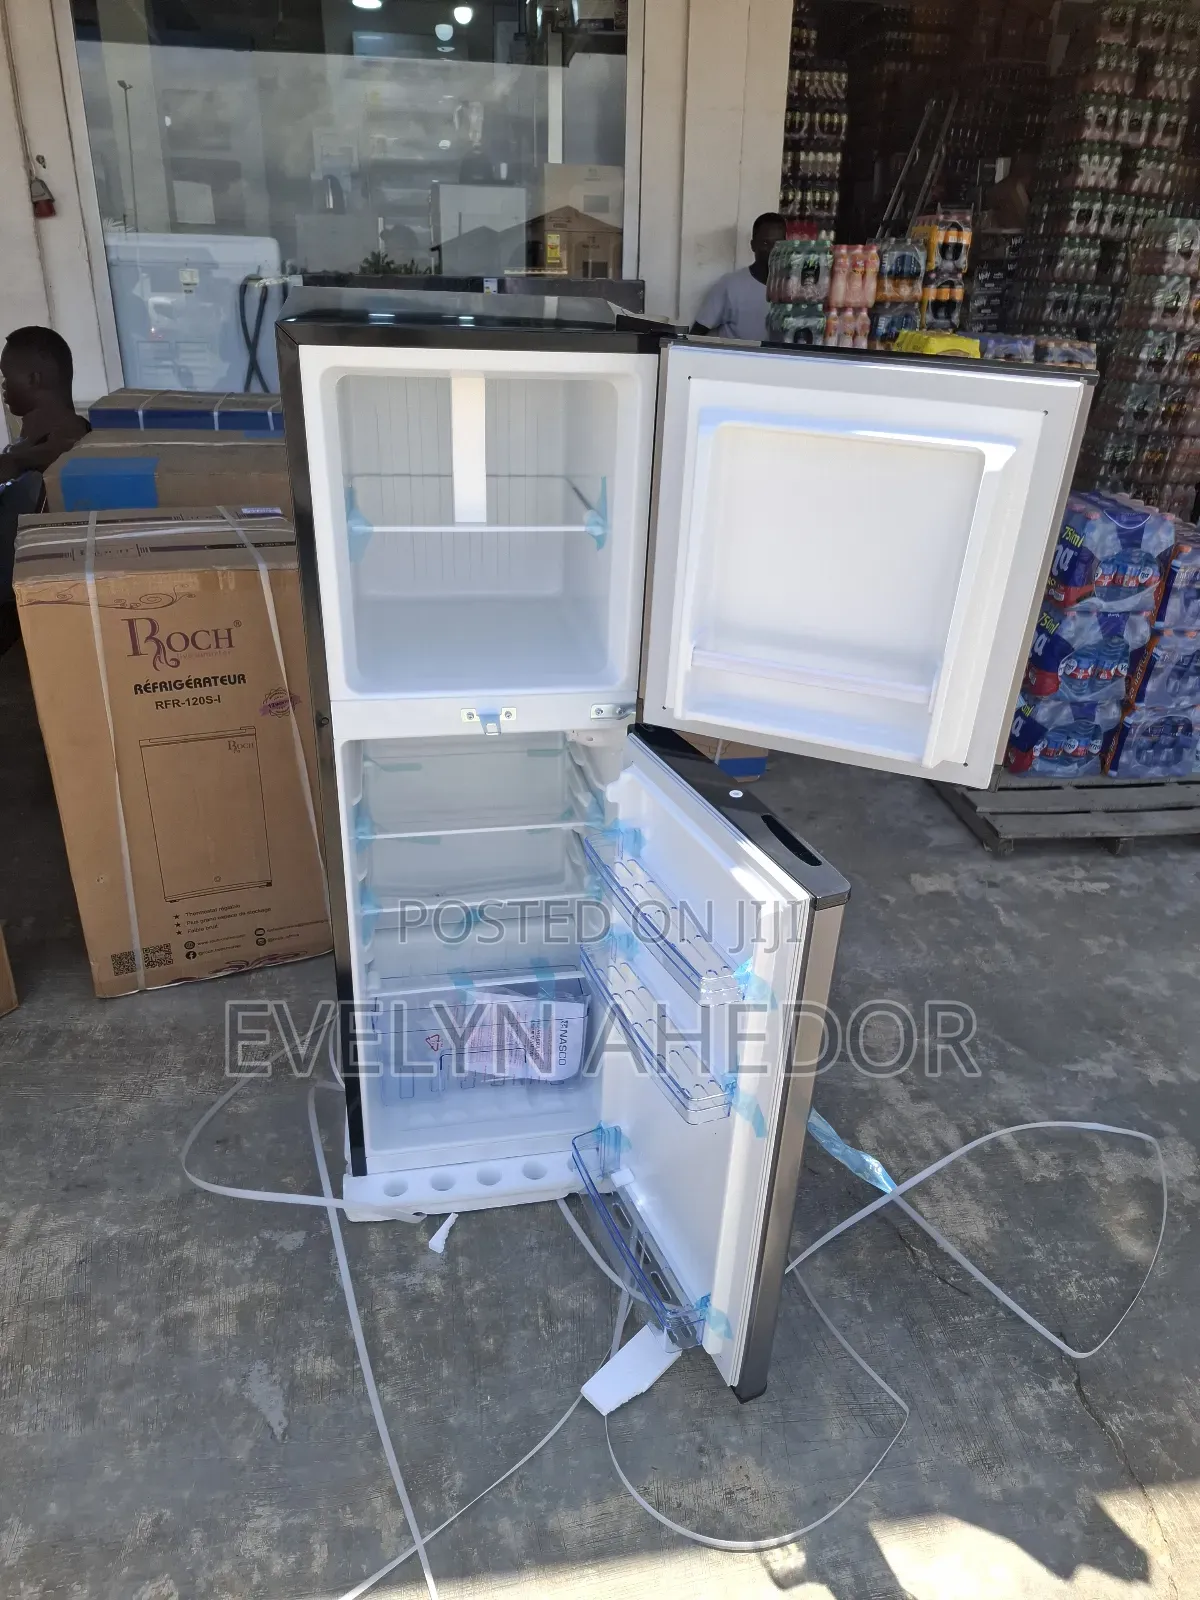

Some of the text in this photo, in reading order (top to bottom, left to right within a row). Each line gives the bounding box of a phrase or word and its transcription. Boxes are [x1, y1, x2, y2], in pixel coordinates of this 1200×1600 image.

[133, 673, 247, 696] RÉFRIGÉRATEUR
[154, 694, 222, 711] RFR-120S-I
[558, 1029, 568, 1066] NASCO
